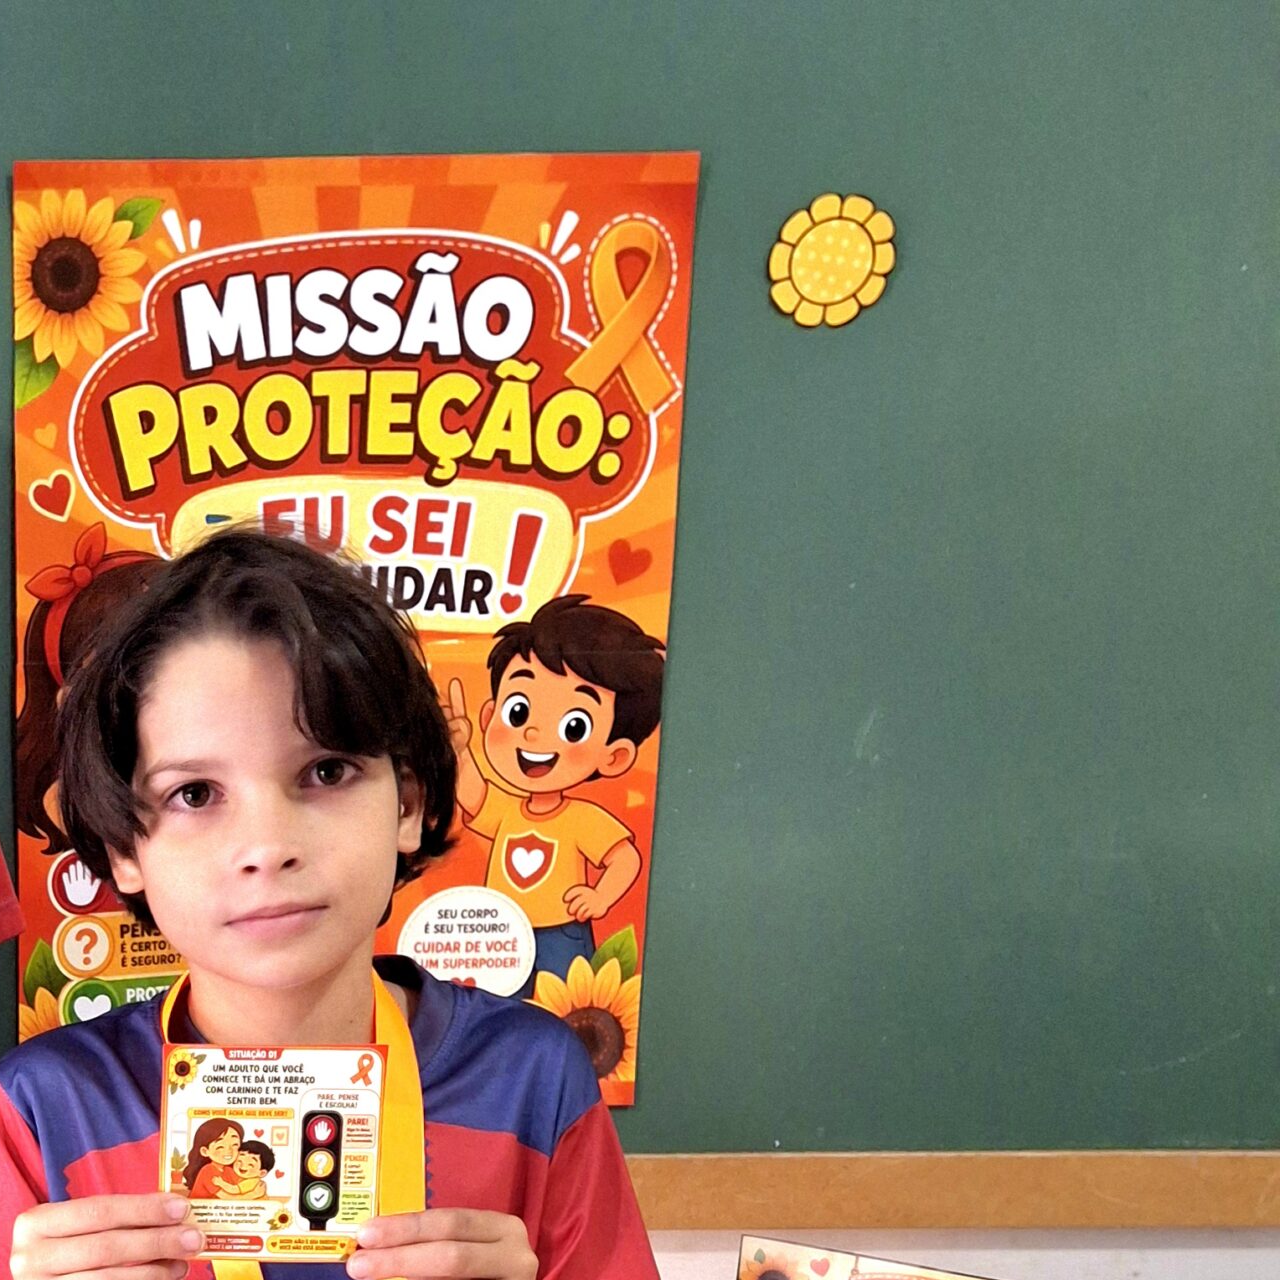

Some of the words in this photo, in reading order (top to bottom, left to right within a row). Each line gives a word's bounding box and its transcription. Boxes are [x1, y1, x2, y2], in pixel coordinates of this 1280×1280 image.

[179, 251, 534, 372] MISSÃO
[109, 360, 631, 493] PROTEÇÃO:
[263, 495, 345, 553] EU
[368, 495, 471, 559] SEI
[438, 910, 457, 919] SEU
[461, 909, 498, 919] CORPO
[424, 922, 430, 934] É
[434, 924, 453, 933] SEU
[458, 923, 509, 933] TESOURO!
[414, 942, 460, 953] CUIDAR
[466, 942, 480, 952] DE
[486, 938, 517, 951] VOCÊ
[121, 956, 127, 967] É
[131, 953, 181, 966] SEGURO?
[421, 959, 438, 968] UM
[443, 958, 520, 969] SUPERPODER!
[229, 1049, 266, 1059] SITUAÇÃO
[268, 1050, 277, 1058] 01
[213, 1064, 225, 1073] UM
[229, 1065, 259, 1073] ADULTO
[263, 1065, 279, 1074] QUE
[282, 1064, 304, 1073] VOCÊ
[202, 1075, 239, 1084] CONHECE
[254, 1074, 265, 1083] DÁ
[268, 1076, 280, 1084] UM
[283, 1076, 315, 1085] ABRAÇO
[206, 1086, 223, 1094] COM
[227, 1086, 263, 1094] CARINHO
[273, 1087, 282, 1095] TE
[284, 1087, 298, 1095] FAZ
[227, 1097, 256, 1105] SENTIR
